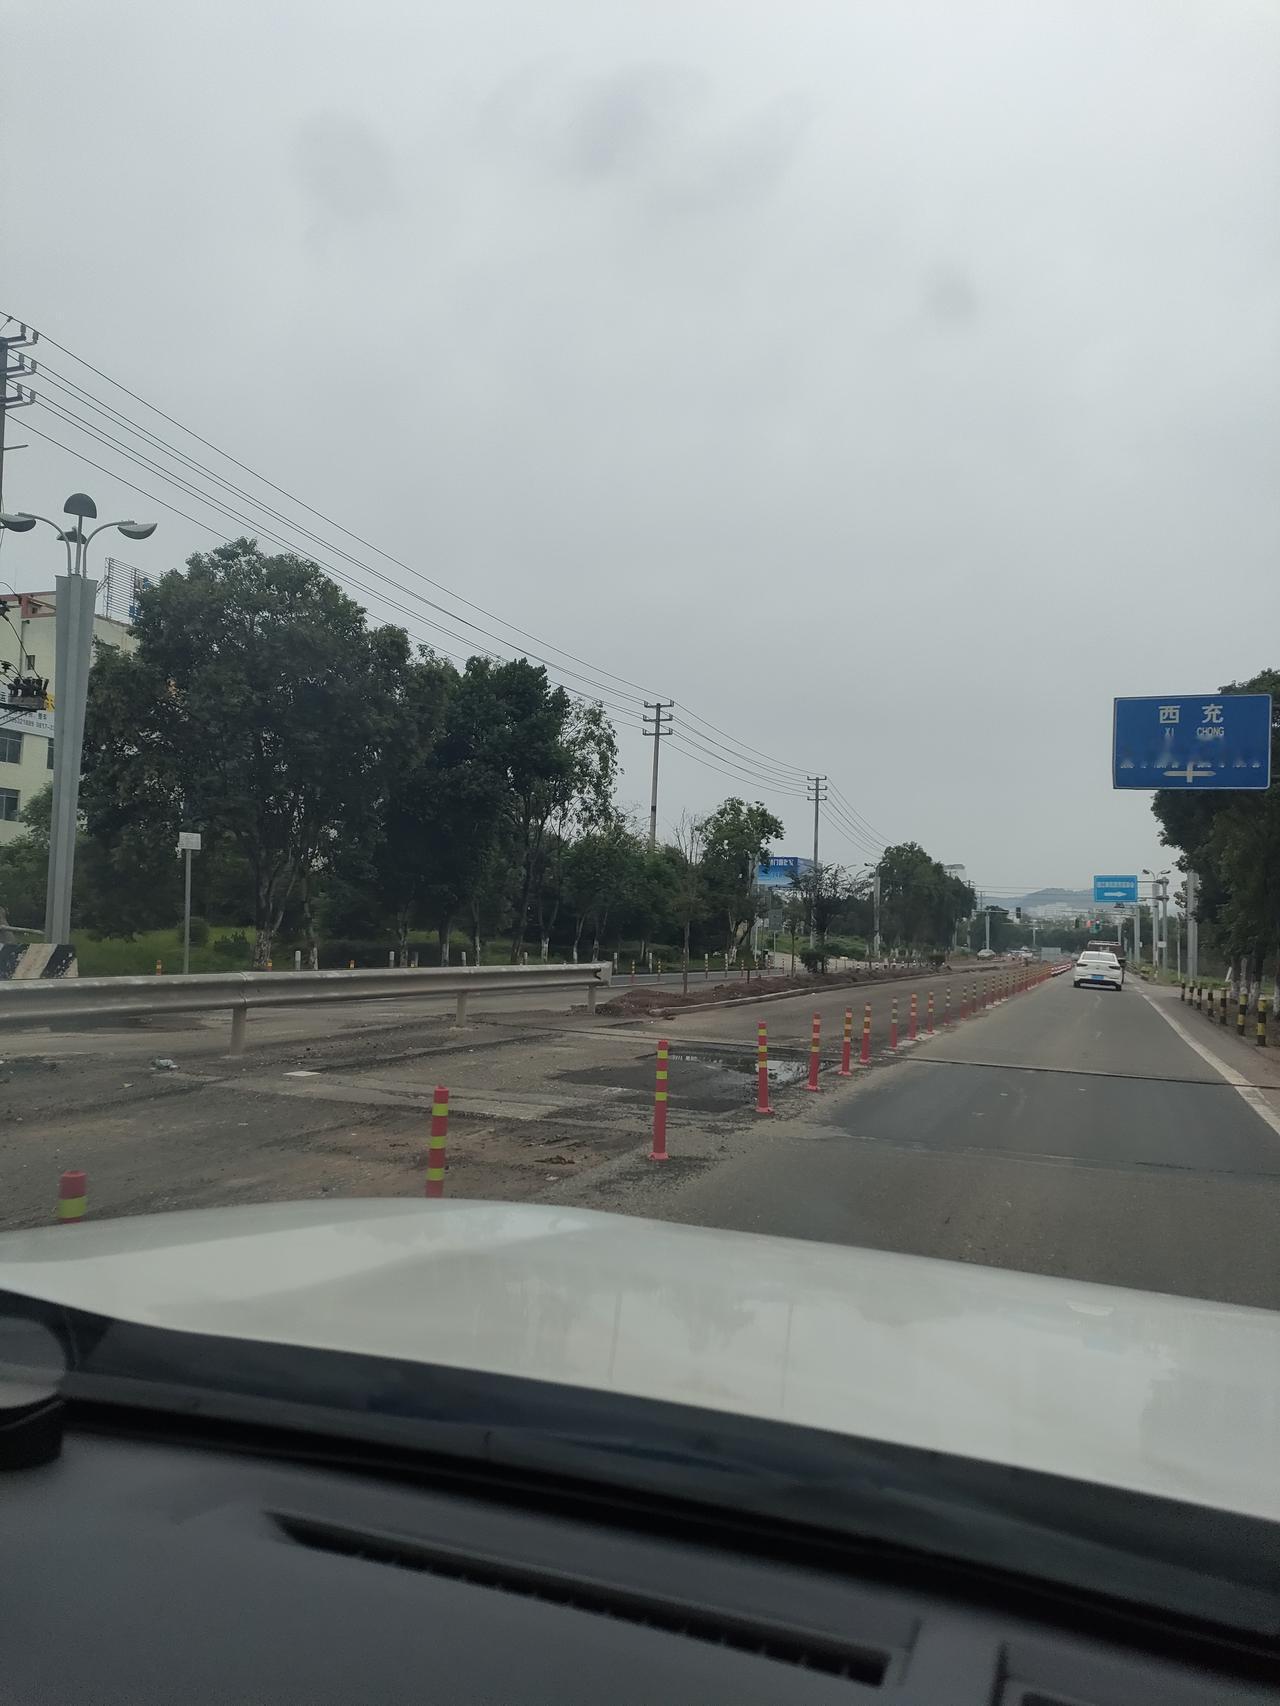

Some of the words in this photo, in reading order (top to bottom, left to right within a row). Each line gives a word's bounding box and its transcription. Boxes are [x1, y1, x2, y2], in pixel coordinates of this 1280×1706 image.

[1158, 704, 1224, 724] 西充
[1164, 727, 1175, 737] XI
[1196, 727, 1225, 737] CHONG
